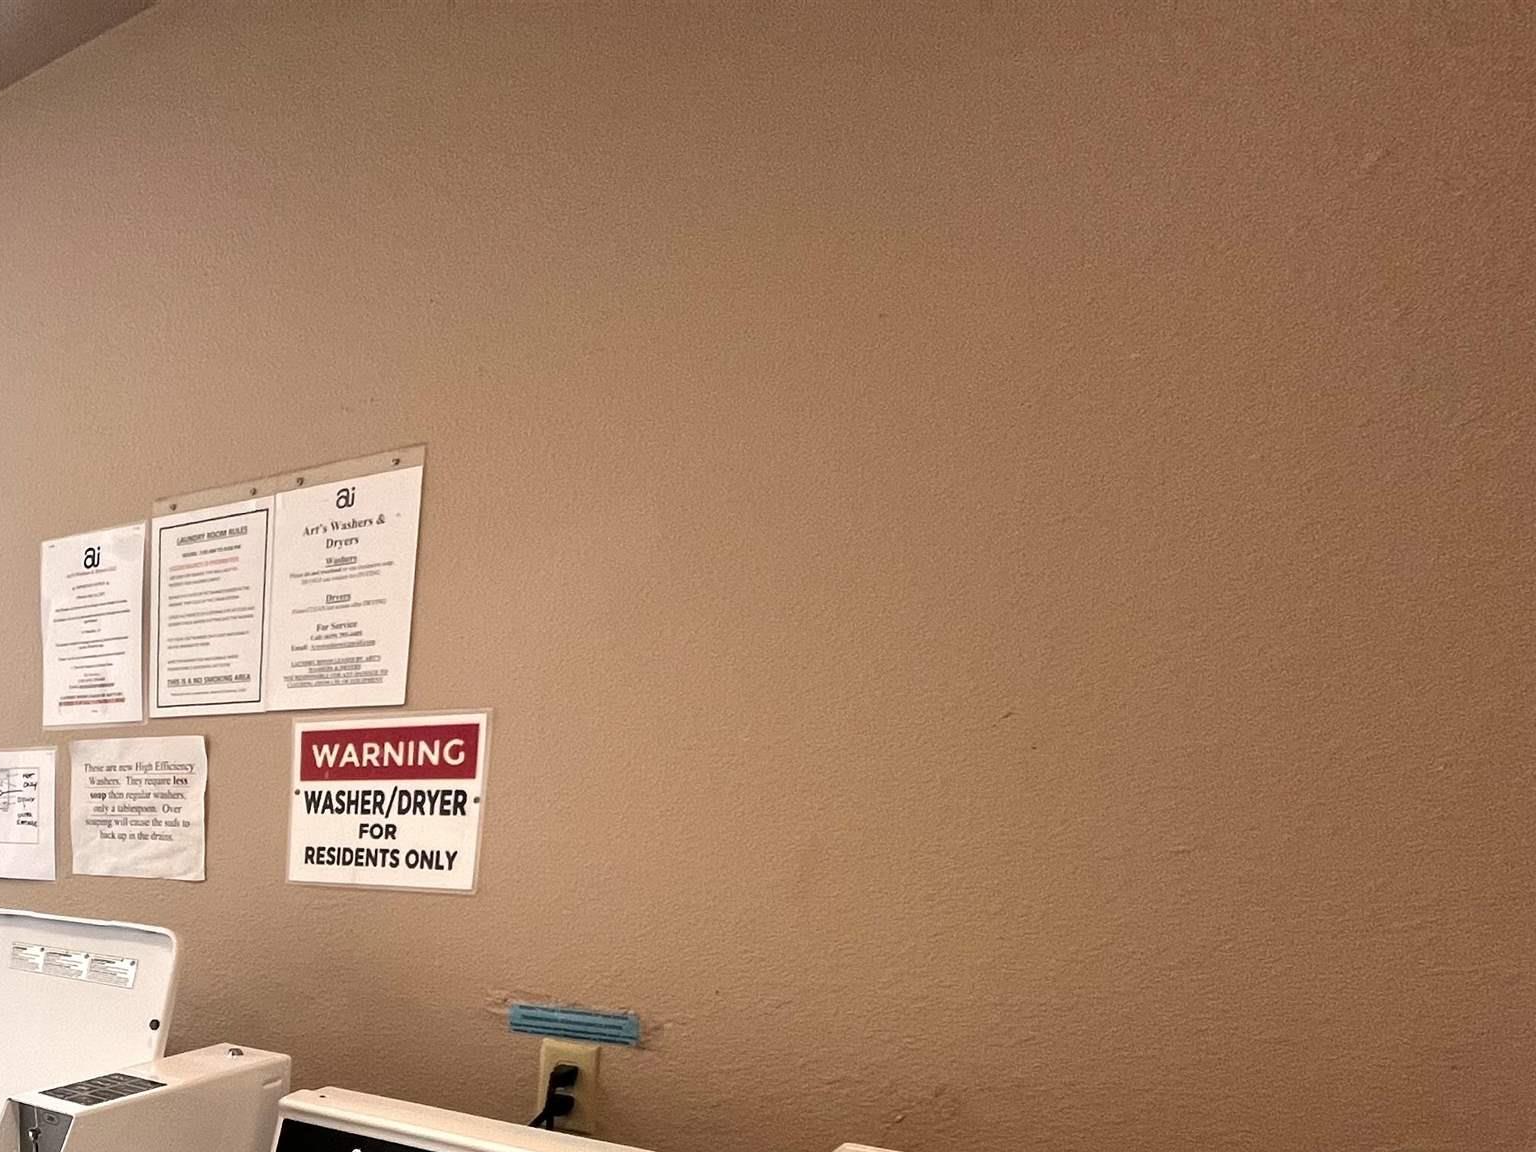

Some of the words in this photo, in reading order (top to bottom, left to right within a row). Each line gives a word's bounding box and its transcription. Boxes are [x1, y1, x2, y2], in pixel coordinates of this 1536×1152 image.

[303, 523, 327, 536] Art's
[331, 518, 373, 532] Washers
[376, 513, 386, 525] &
[176, 533, 205, 545] LAUNDRY
[206, 530, 227, 539] ROOM
[229, 525, 248, 535] RULES
[326, 537, 359, 549] Dryers
[325, 555, 357, 566] Washers
[331, 621, 358, 631] Service
[204, 675, 232, 683] SMOKING
[234, 673, 251, 682] AREA
[312, 738, 465, 768] WARNING
[84, 763, 104, 773] These
[105, 764, 117, 772] are
[119, 764, 133, 772] new
[135, 762, 153, 774] High
[155, 761, 194, 773] Efficiency
[126, 776, 142, 787] They
[144, 777, 171, 787] require
[173, 776, 188, 785] less
[90, 791, 107, 801] soap
[126, 790, 151, 801] regular
[304, 786, 468, 819] WASHER/DRYER
[93, 804, 109, 815] only
[162, 804, 182, 814] Over
[114, 818, 128, 827] will
[130, 819, 150, 827] cause
[151, 818, 162, 827] the
[164, 818, 180, 828] suds
[182, 819, 190, 828] to
[99, 830, 115, 840] back
[117, 832, 127, 842] up
[129, 831, 136, 840] in
[137, 831, 149, 840] the
[359, 823, 397, 840] FOR
[304, 846, 400, 869] RESIDENTS
[405, 849, 458, 871] ONLY
